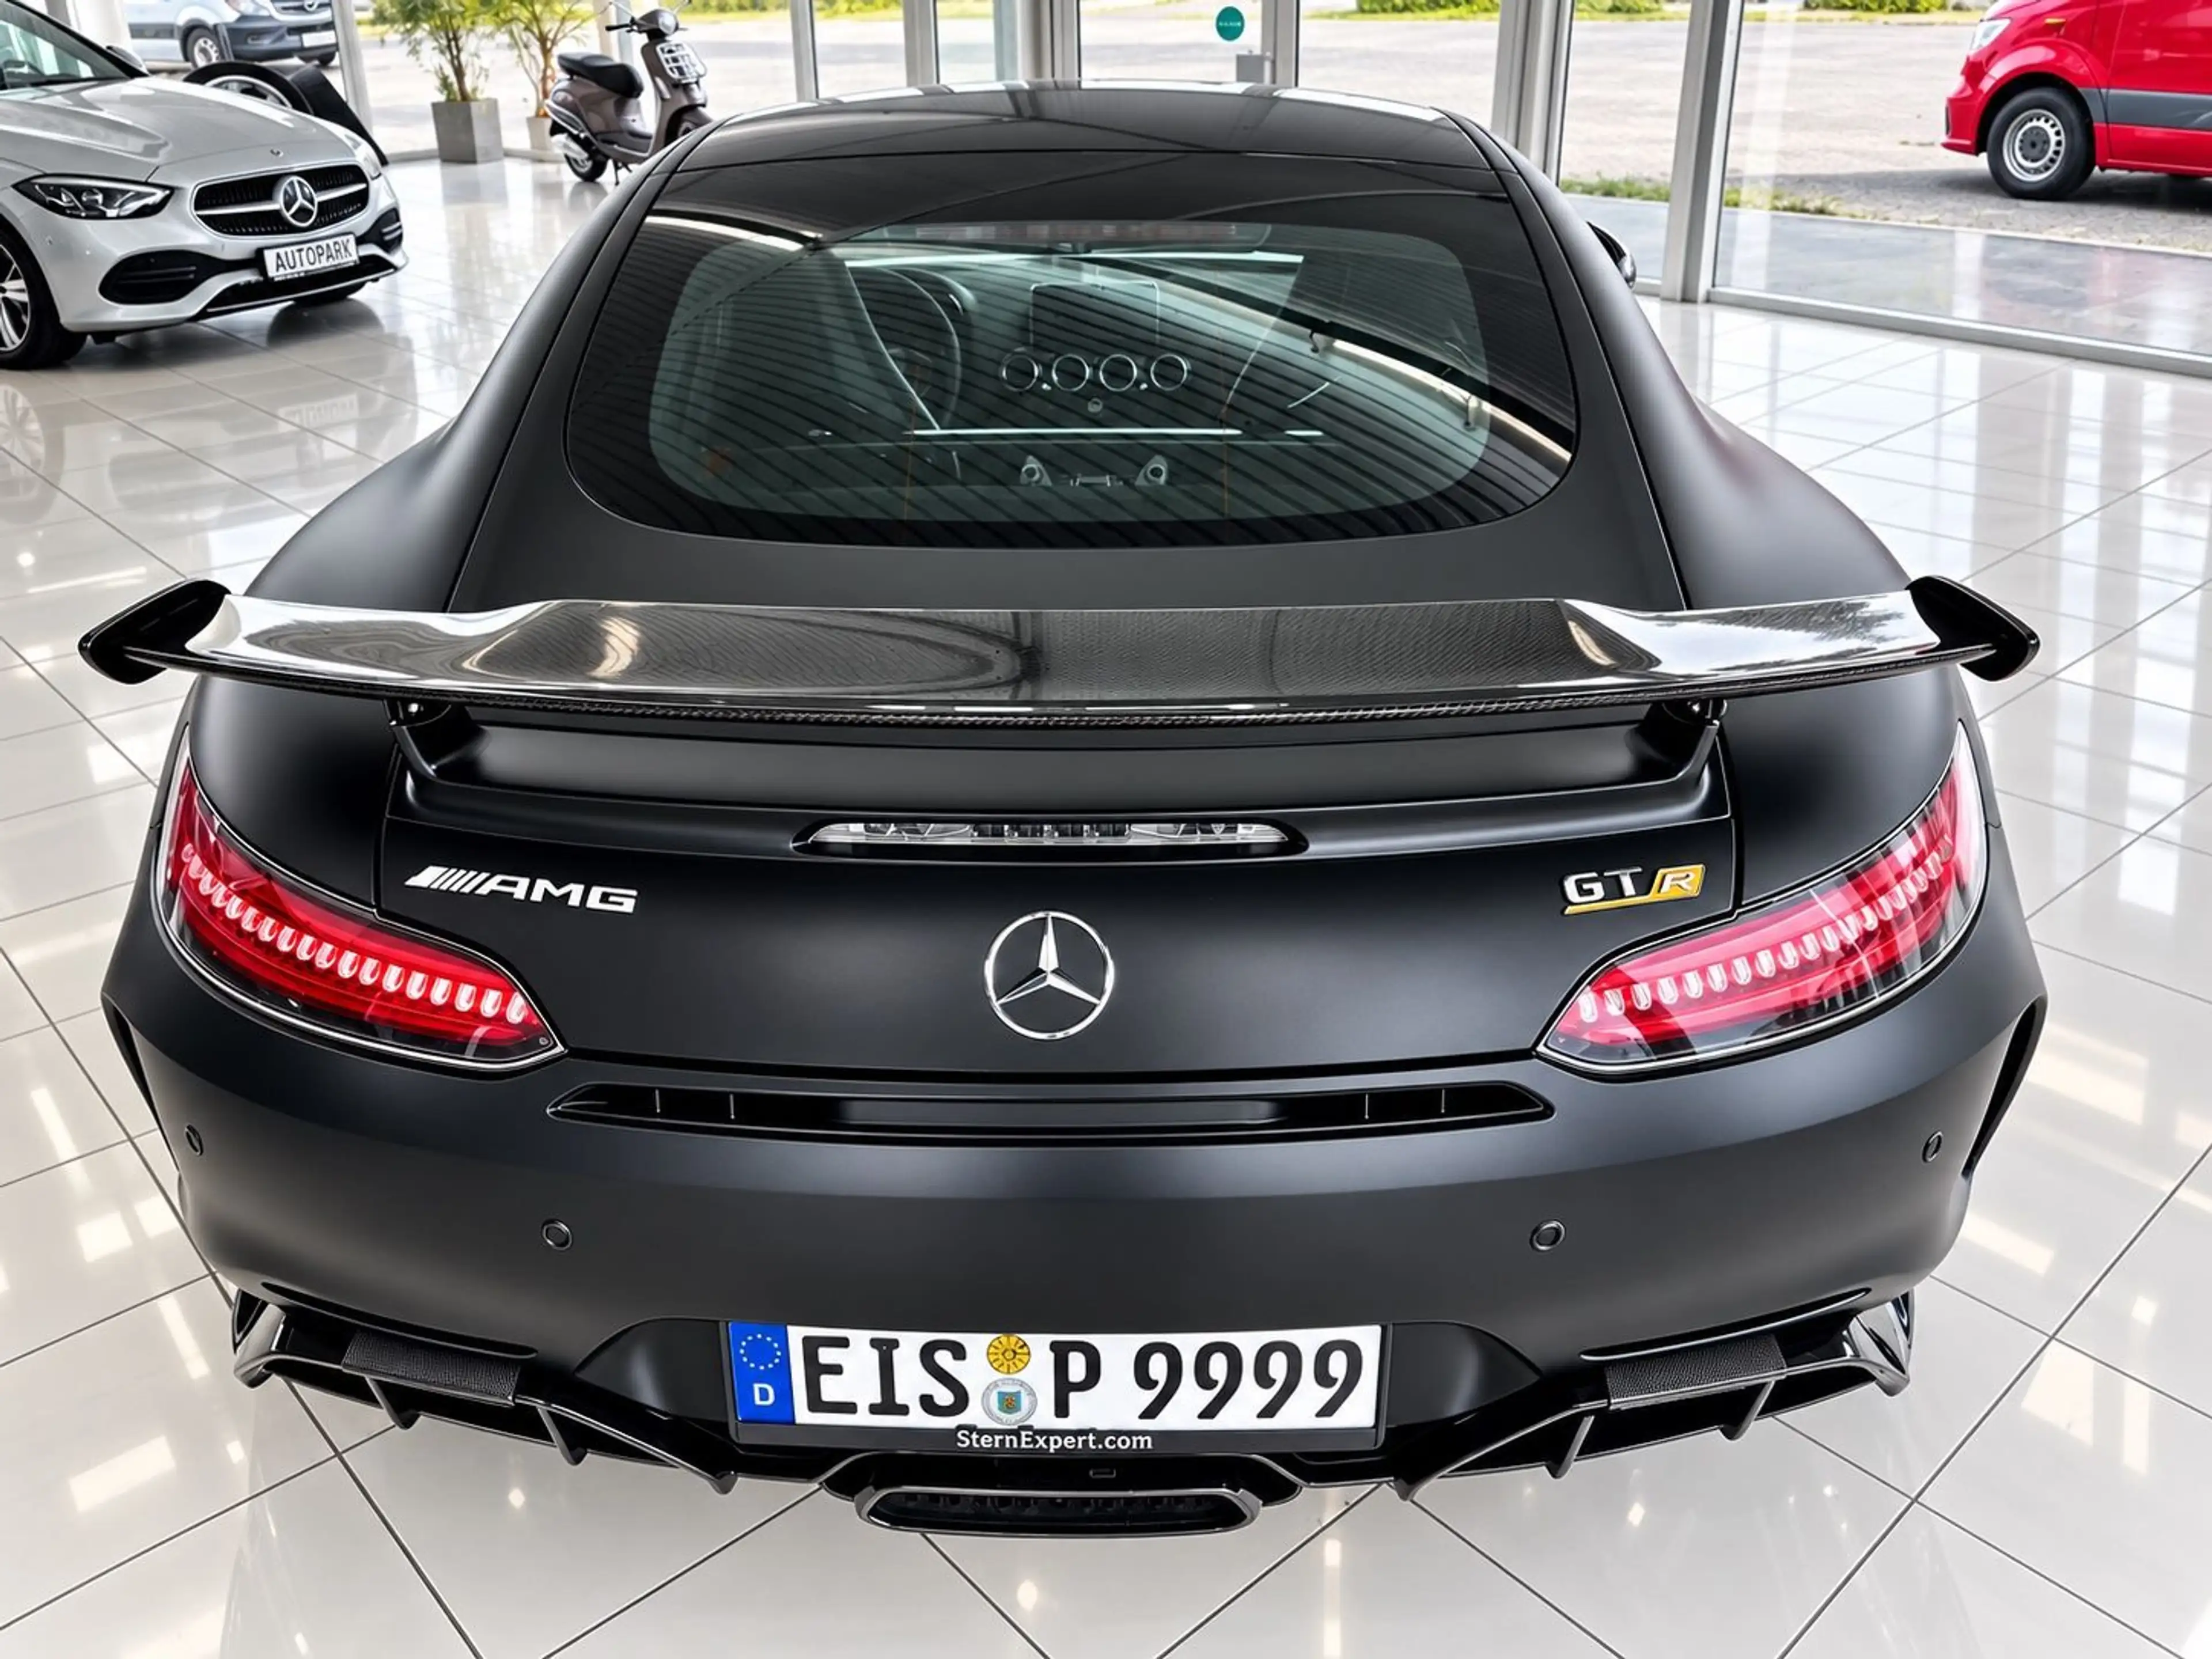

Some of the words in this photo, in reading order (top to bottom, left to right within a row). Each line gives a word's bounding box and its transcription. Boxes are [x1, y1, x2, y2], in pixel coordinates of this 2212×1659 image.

[276, 238, 353, 272] AUTOPARK
[474, 873, 638, 914] AMG
[1563, 866, 1642, 904] GT
[753, 1383, 776, 1406] D
[802, 1335, 969, 1418] EIS
[1049, 1339, 1101, 1419] P
[1133, 1339, 1363, 1420] 9999
[956, 1429, 1153, 1454] SternExpert.com
